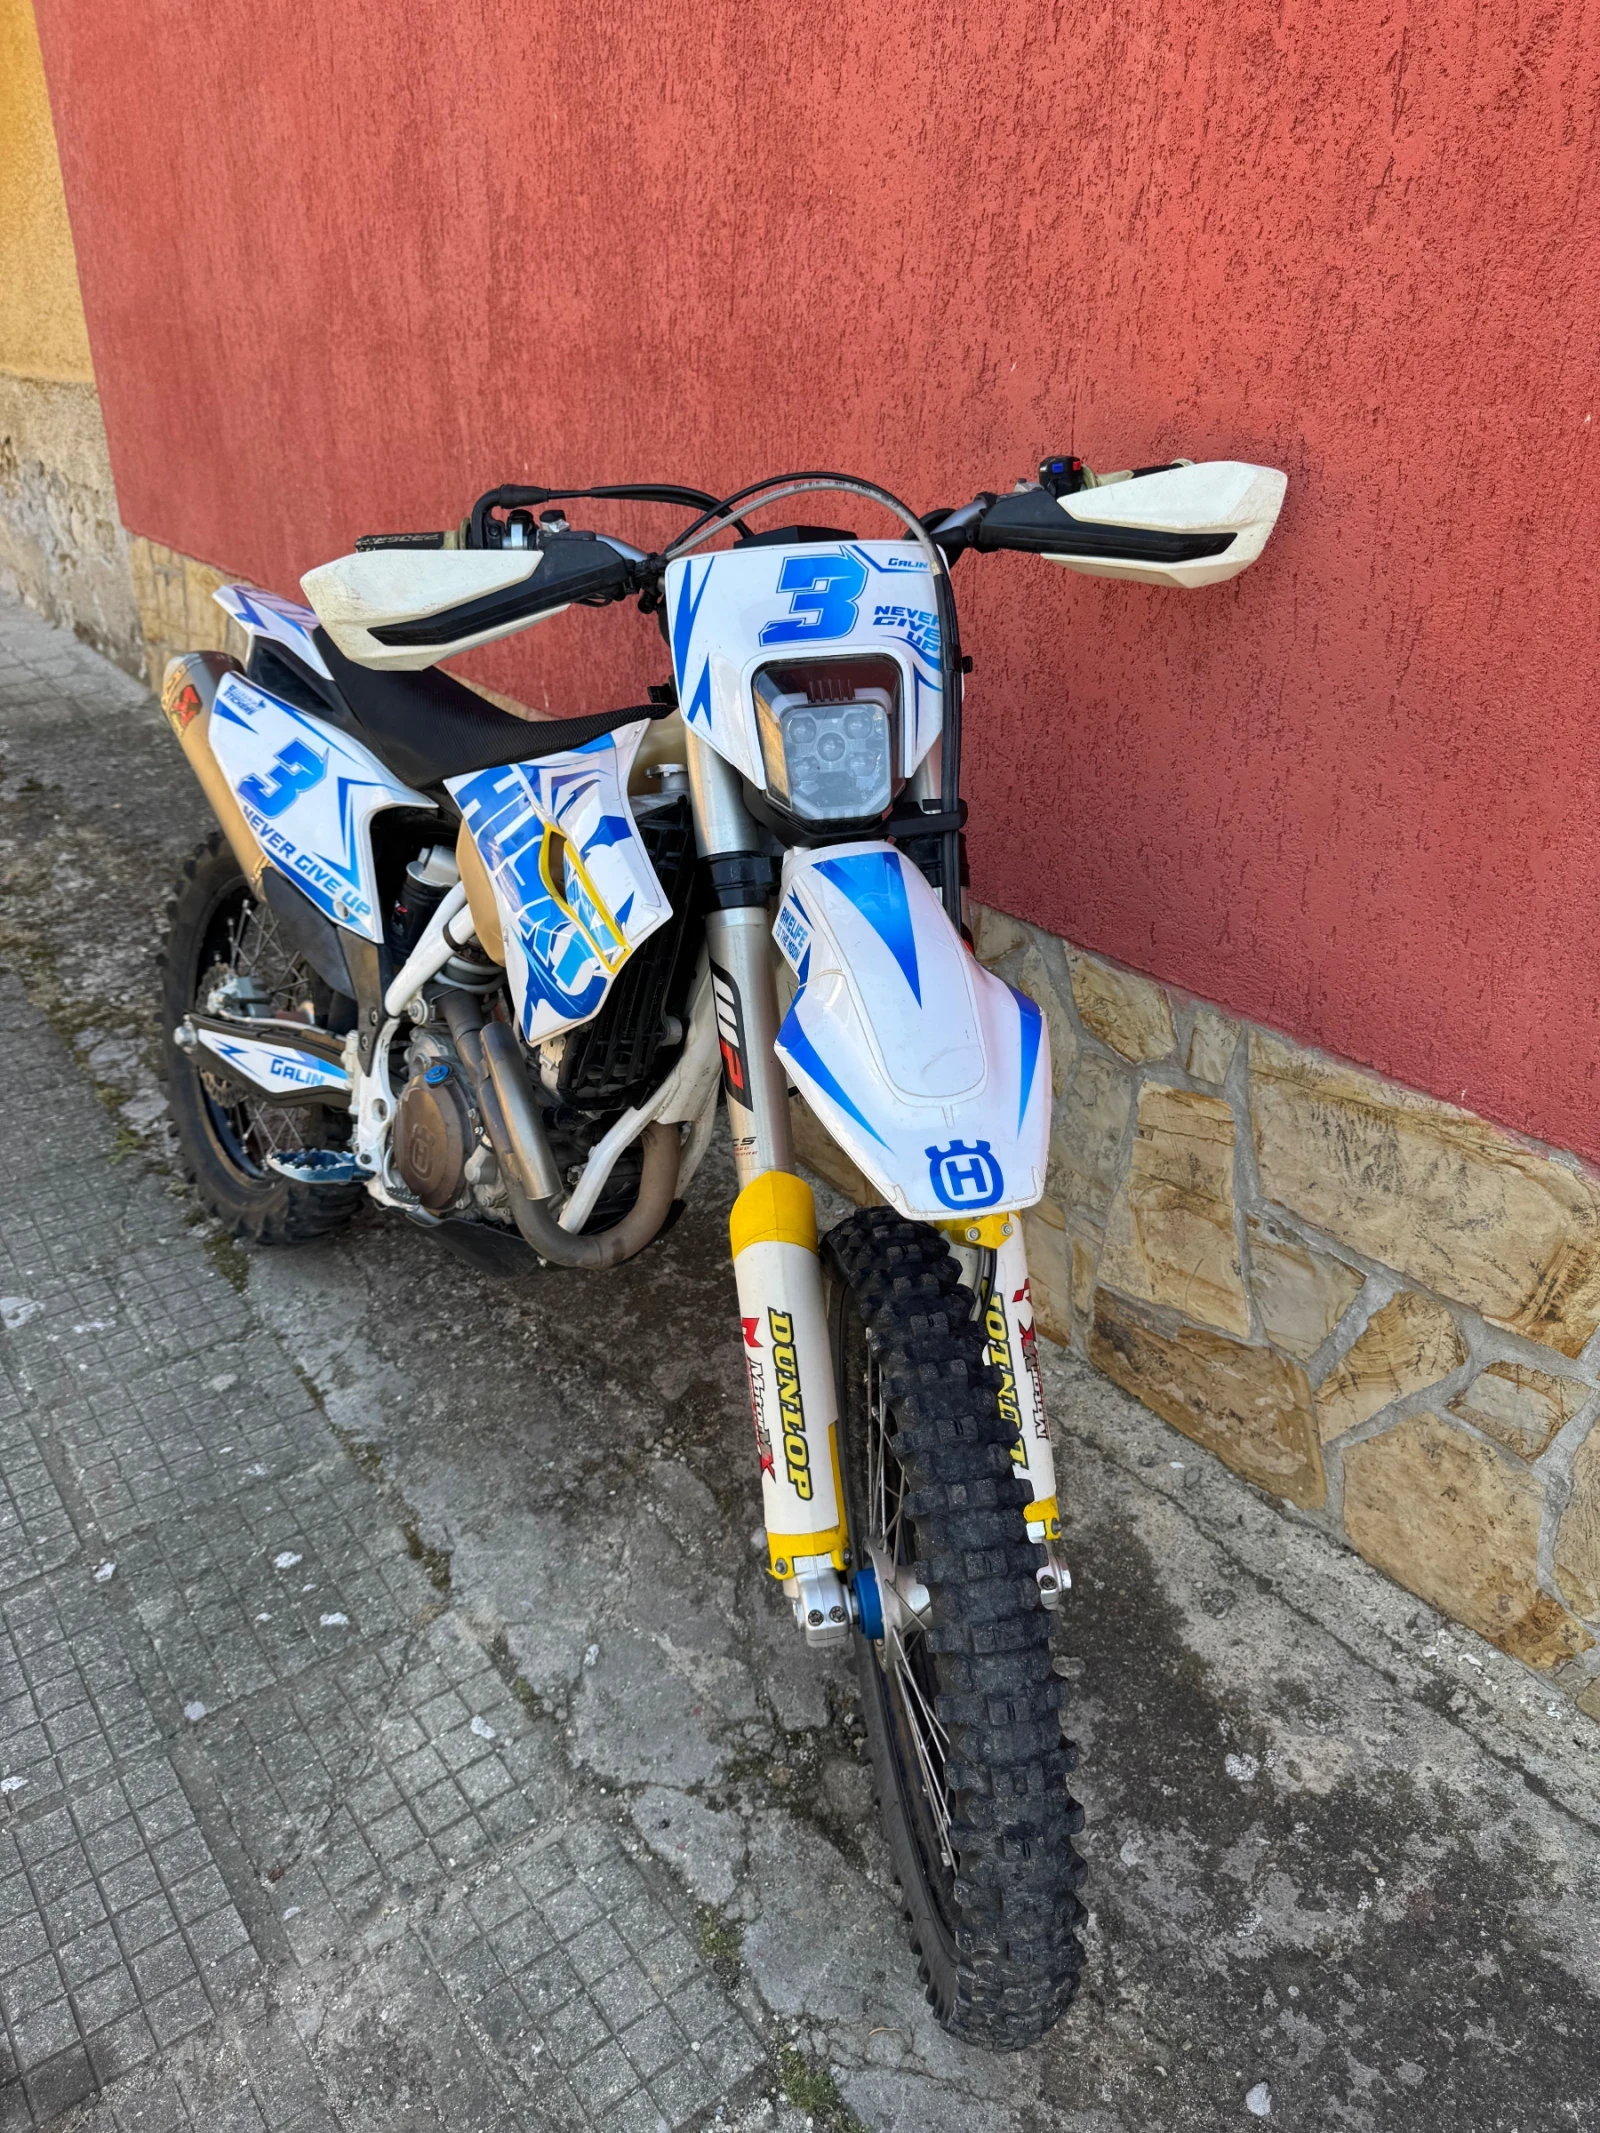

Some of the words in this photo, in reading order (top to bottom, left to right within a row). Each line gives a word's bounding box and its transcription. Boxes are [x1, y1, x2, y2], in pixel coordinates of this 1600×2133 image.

[888, 557, 928, 569] GALIN
[758, 545, 869, 647] 3
[873, 616, 940, 643] GIVE
[906, 631, 940, 652] UP
[236, 737, 329, 820] 3
[243, 804, 297, 859] NEVER
[293, 854, 343, 895] GIVE
[341, 890, 371, 916] UP
[269, 1058, 325, 1086] GALIN
[767, 1306, 814, 1501] DUNLOP
